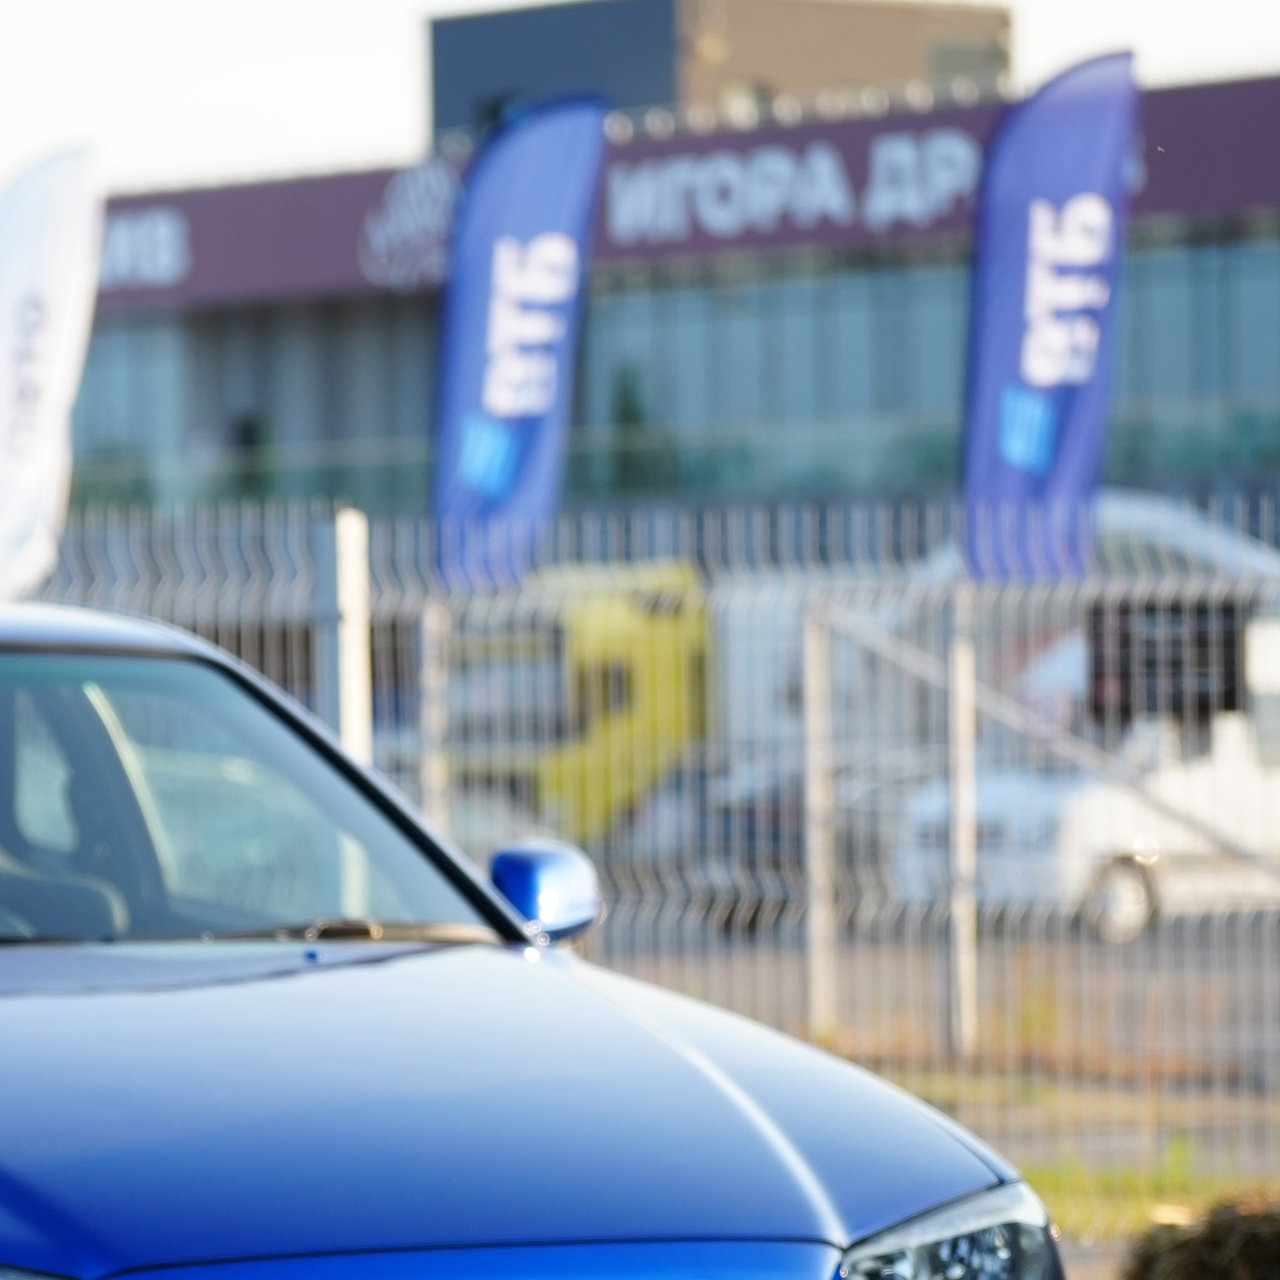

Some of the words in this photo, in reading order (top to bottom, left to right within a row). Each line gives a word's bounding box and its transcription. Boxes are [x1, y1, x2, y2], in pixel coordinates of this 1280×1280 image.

[607, 141, 856, 245] ИГОРА
[482, 232, 578, 418] ВТБ
[1021, 192, 1114, 387] ВТБ
